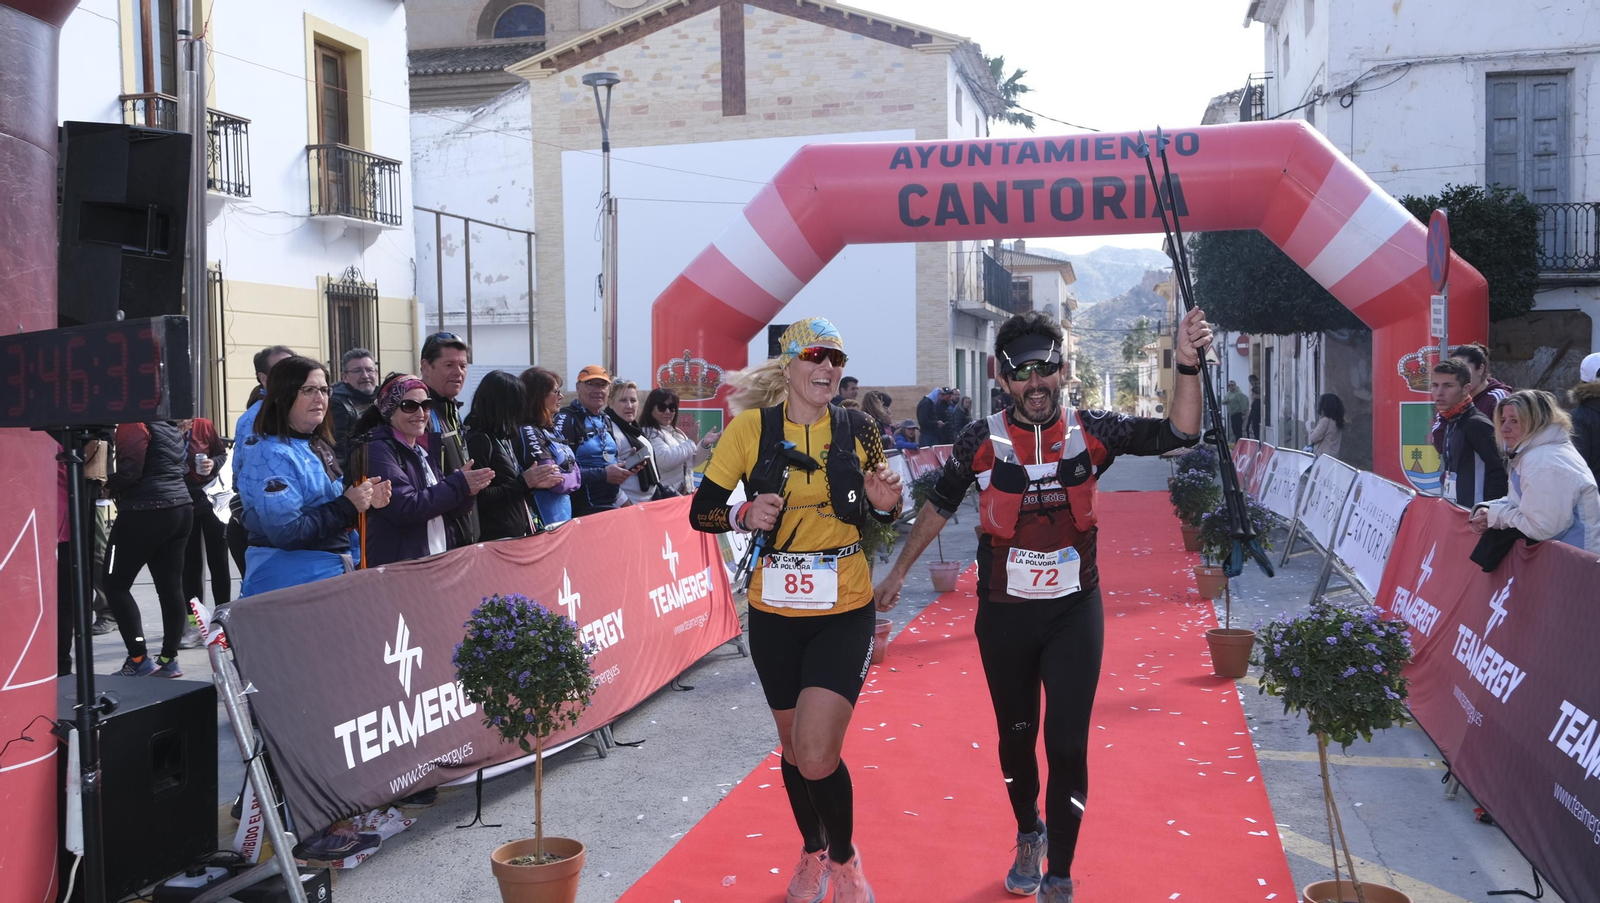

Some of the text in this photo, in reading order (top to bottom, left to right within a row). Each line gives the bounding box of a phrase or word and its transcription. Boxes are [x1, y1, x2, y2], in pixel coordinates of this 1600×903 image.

[889, 132, 1200, 170] AYUNTAMIENTO
[898, 172, 1190, 227] CANTORIA
[8, 329, 161, 417] 3:46:33
[649, 565, 713, 618] TEAMERGY
[785, 574, 814, 594] 85
[1030, 568, 1059, 586] 72
[580, 608, 625, 659] ERGY
[1390, 586, 1442, 637] TEAMERGY
[1451, 623, 1527, 704] TEAMERGY
[334, 681, 477, 770] TEAMERG
